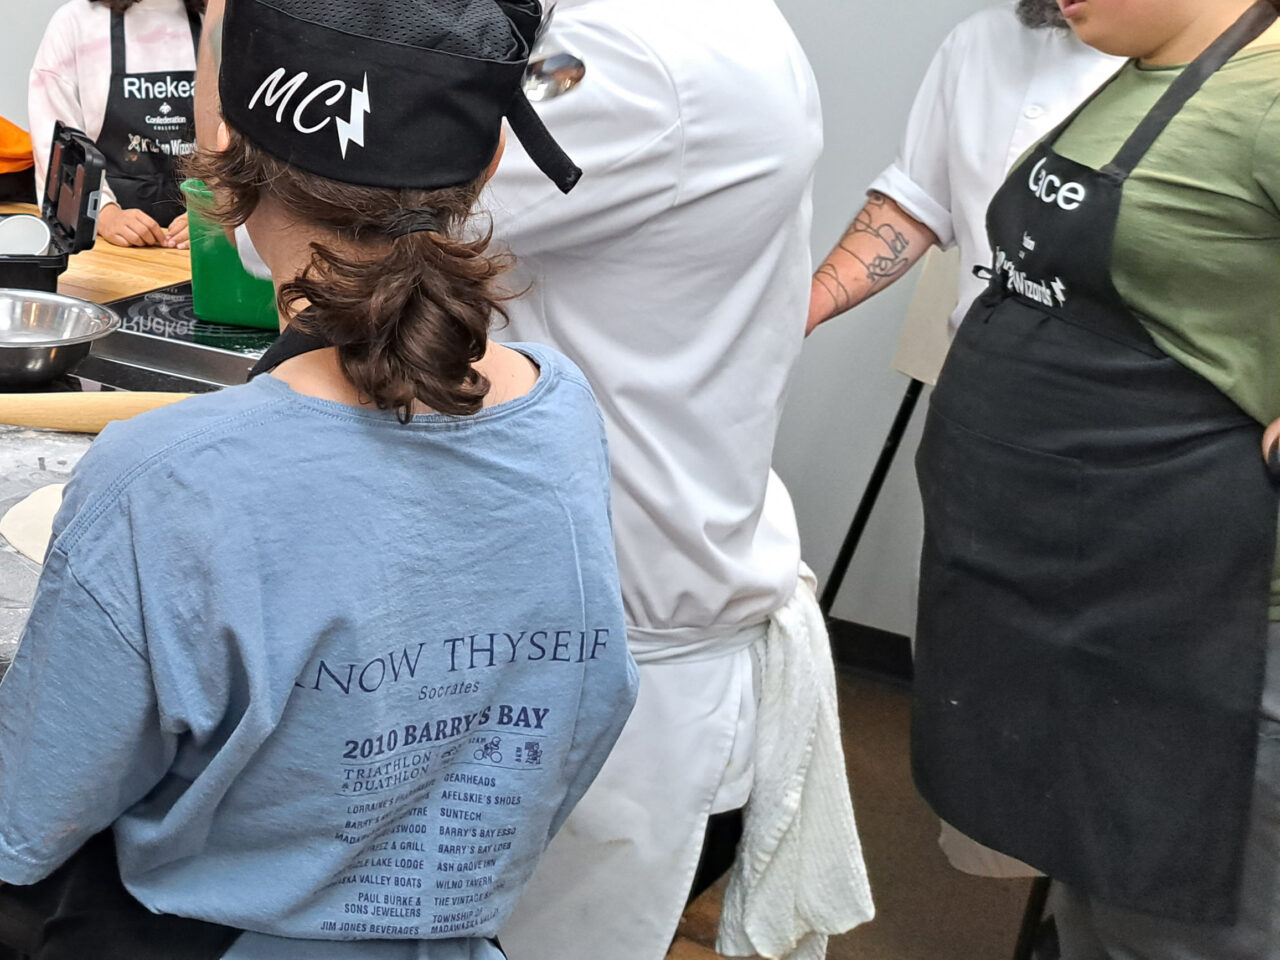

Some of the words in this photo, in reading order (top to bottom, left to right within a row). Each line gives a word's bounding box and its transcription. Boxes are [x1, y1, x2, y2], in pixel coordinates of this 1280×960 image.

[248, 67, 346, 133] MC
[294, 643, 424, 694] NOW
[419, 681, 480, 700] Socrates
[342, 729, 398, 759] 2010
[403, 705, 491, 746] BARRY'S
[496, 704, 550, 729] BAY
[343, 751, 432, 780] TRIATHLON
[353, 764, 430, 792] DUATHLON
[443, 773, 496, 788] GEARHEADS
[441, 790, 492, 805] AFELSKIE'S
[494, 795, 522, 806] SHOES
[440, 807, 481, 821] SUNTECH
[440, 826, 477, 838] BARRY'S
[480, 828, 496, 838] BAY
[400, 841, 425, 852] GRILL
[438, 844, 475, 854] BARRY'S
[371, 857, 392, 867] LAKE
[395, 858, 425, 870] LODGE
[437, 862, 454, 872] ASH
[359, 874, 391, 886] VALLEY
[394, 876, 422, 888] BOATS
[436, 880, 463, 889] WILNO
[358, 892, 381, 904] PAUL
[384, 894, 413, 906] BURKE
[434, 897, 449, 906] THE
[344, 903, 369, 915] SONS
[371, 906, 421, 918] JEWELLERS
[433, 912, 473, 923] TOWNSHIP
[321, 921, 336, 932] JIM
[339, 922, 367, 933] JONES
[369, 924, 420, 936] BEVERAGES
